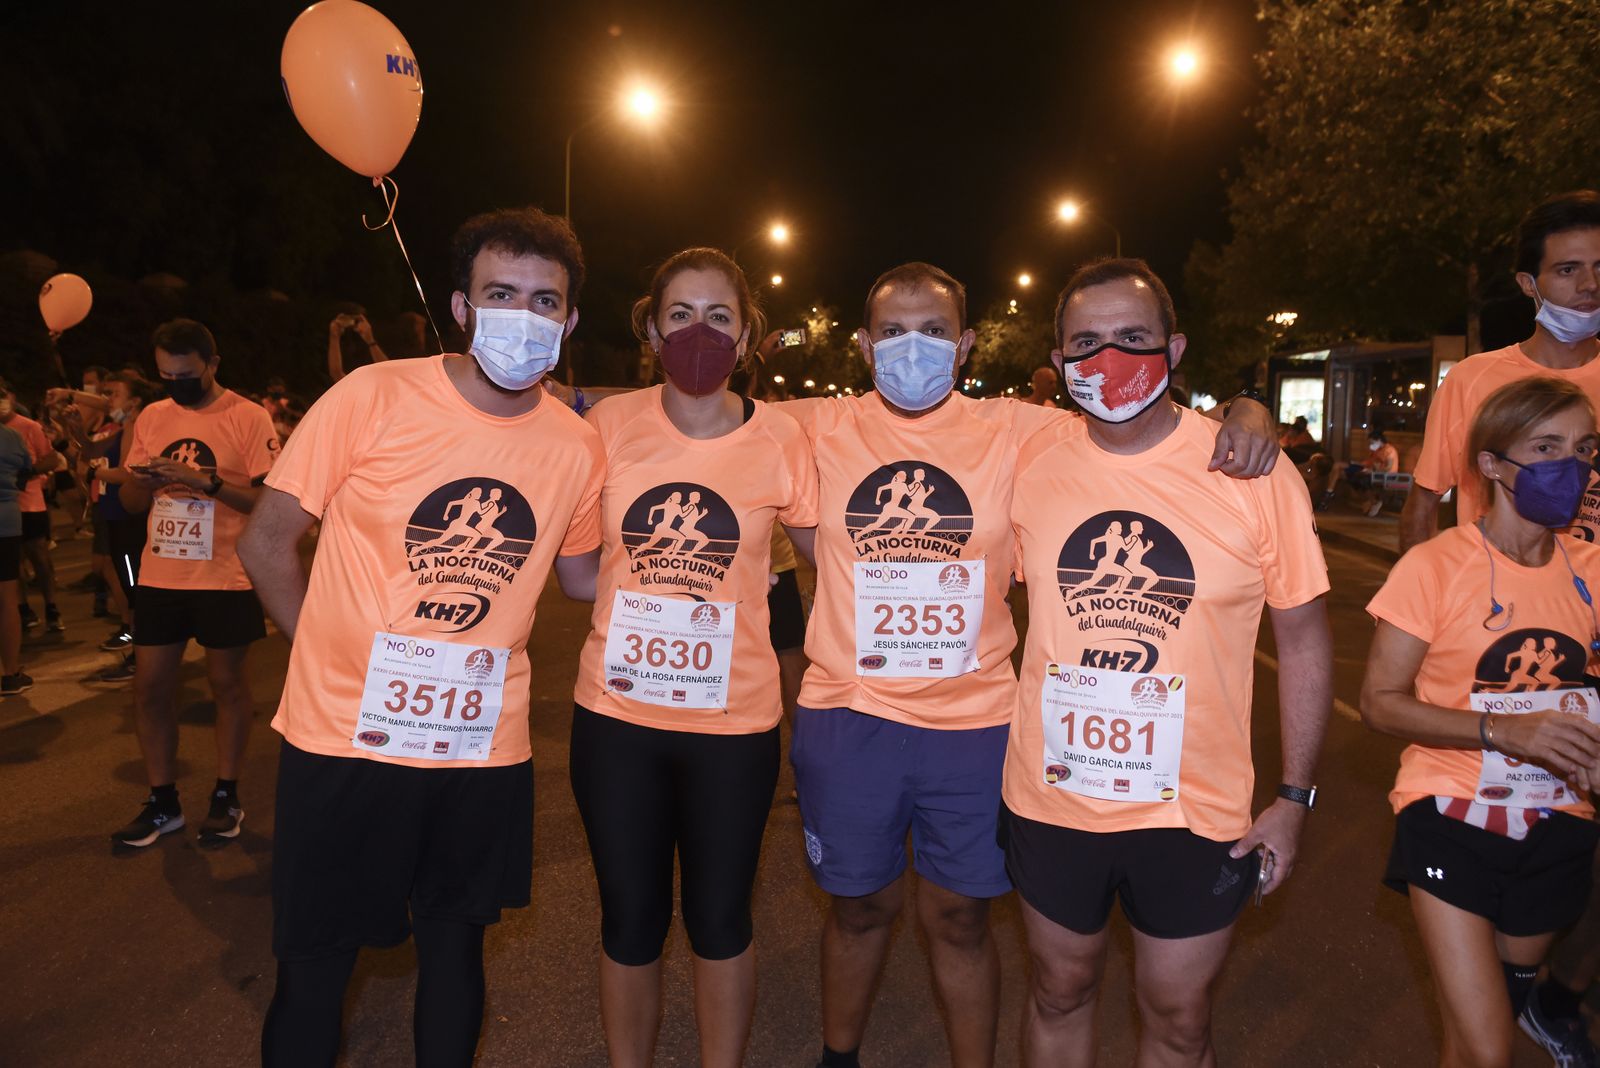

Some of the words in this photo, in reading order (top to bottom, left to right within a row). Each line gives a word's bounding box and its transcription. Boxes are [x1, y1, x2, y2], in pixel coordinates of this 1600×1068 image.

[157, 520, 202, 538] 4974
[856, 542, 874, 557] LA
[876, 538, 961, 558] NOCTURNA
[408, 558, 428, 572] LA
[434, 556, 516, 584] NOCTURNA
[631, 561, 646, 574] LA
[650, 558, 725, 581] NOCTURNA
[418, 572, 433, 586] del
[436, 570, 501, 594] Guadalquivir
[640, 573, 652, 586] del
[653, 572, 714, 592] Guadalquivir
[874, 604, 966, 636] 2353
[1066, 602, 1086, 617] LA
[1090, 598, 1181, 630] NOCTURNA
[645, 627, 669, 636] NOCTURNA
[1078, 616, 1094, 631] del
[1095, 614, 1167, 640] Guadalquivir
[623, 634, 712, 671] 3630
[389, 670, 411, 678] CARRERA
[412, 674, 440, 682] NOCTURNA
[652, 672, 674, 681] ROSA
[384, 680, 483, 721] 3518
[1080, 704, 1107, 713] NOCTURNA
[1119, 710, 1158, 718] GUADALQUIVIR
[362, 712, 387, 723] VICTOR
[388, 717, 416, 728] MANUEL
[418, 722, 463, 733] MONTESINOS
[1061, 711, 1155, 756] 1681
[1064, 752, 1087, 764] DAVID
[1089, 757, 1123, 769] GARCIA
[1126, 762, 1152, 770] RIVAS
